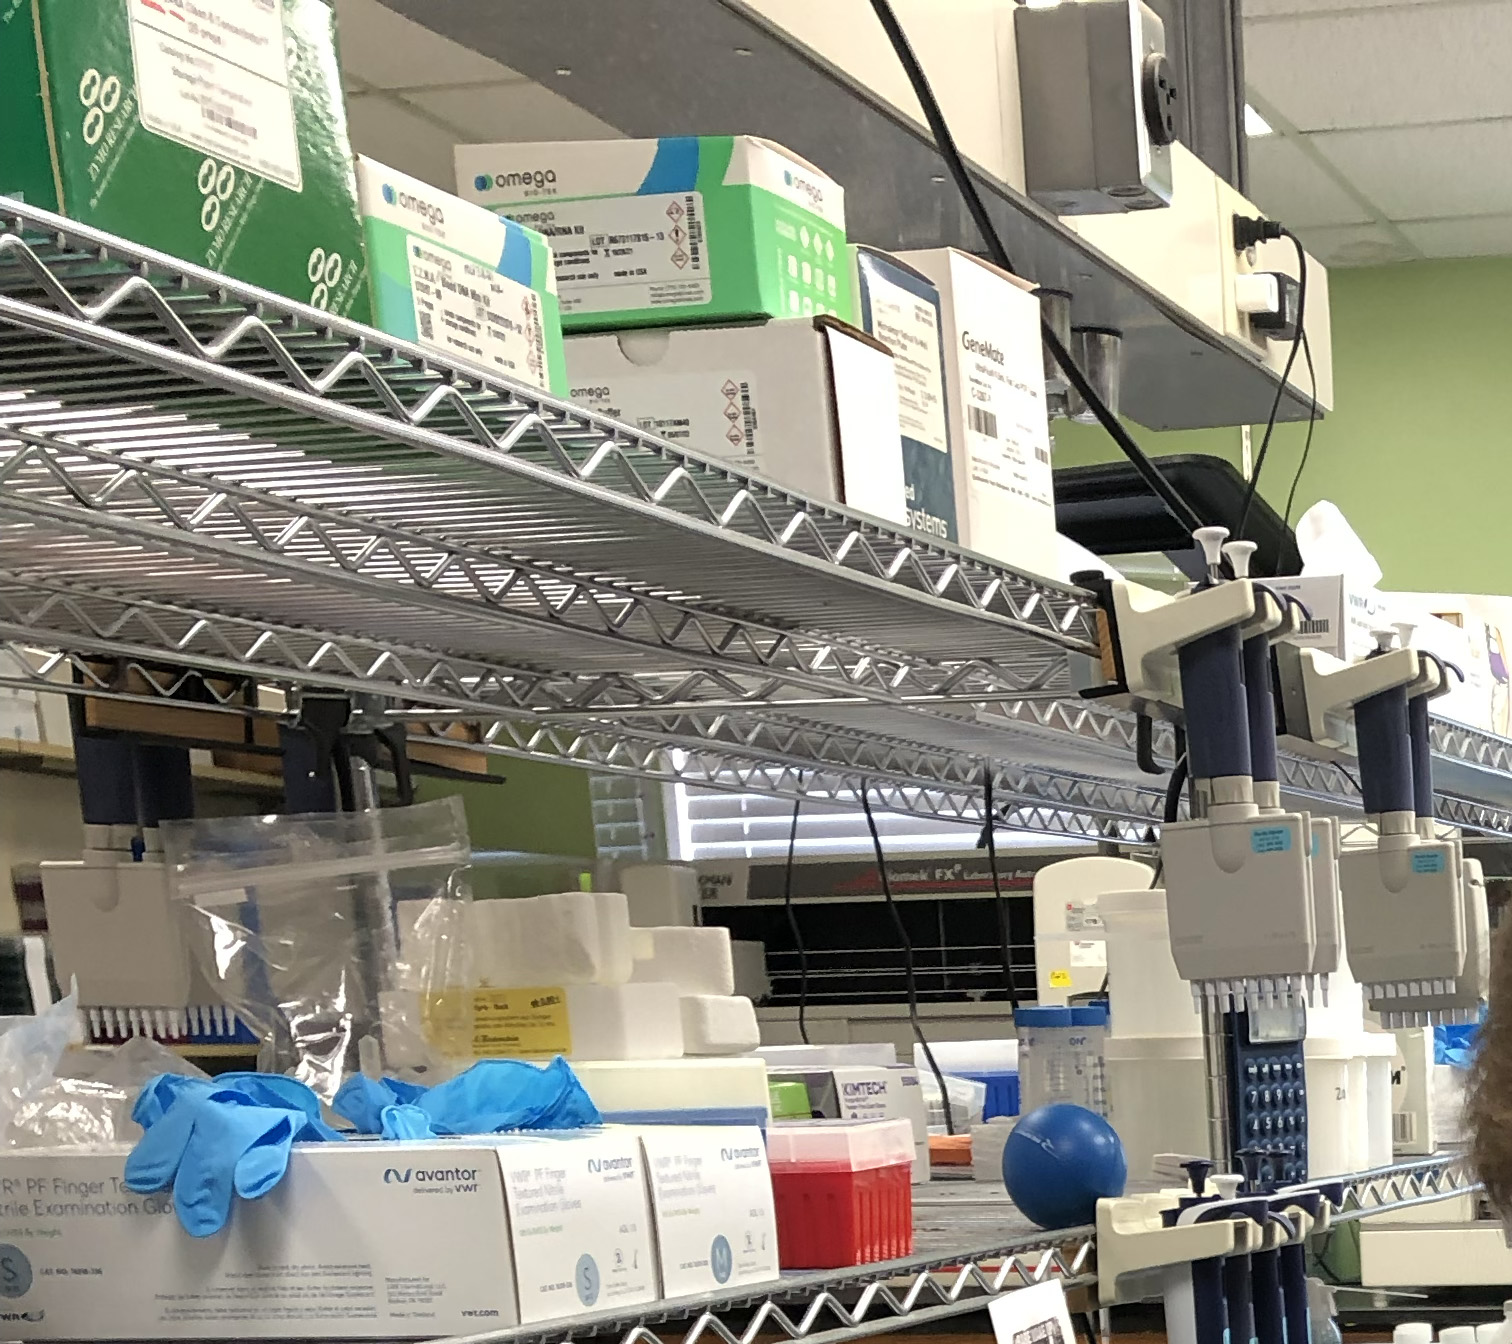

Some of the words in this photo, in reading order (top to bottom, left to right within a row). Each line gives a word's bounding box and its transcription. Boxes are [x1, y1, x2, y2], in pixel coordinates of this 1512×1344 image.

[495, 169, 556, 189] omega
[399, 192, 444, 226] omega
[516, 211, 555, 223] omega
[962, 331, 1004, 366] GeneMate
[570, 386, 610, 399] omega
[843, 1081, 887, 1096] KIMTECH
[415, 1168, 477, 1182] avantor
[27, 1178, 47, 1193] PF
[52, 1177, 105, 1197] Finger
[34, 1200, 138, 1217] Examination
[715, 1248, 727, 1267] M
[1, 1257, 17, 1283] S
[583, 1267, 592, 1290] S
